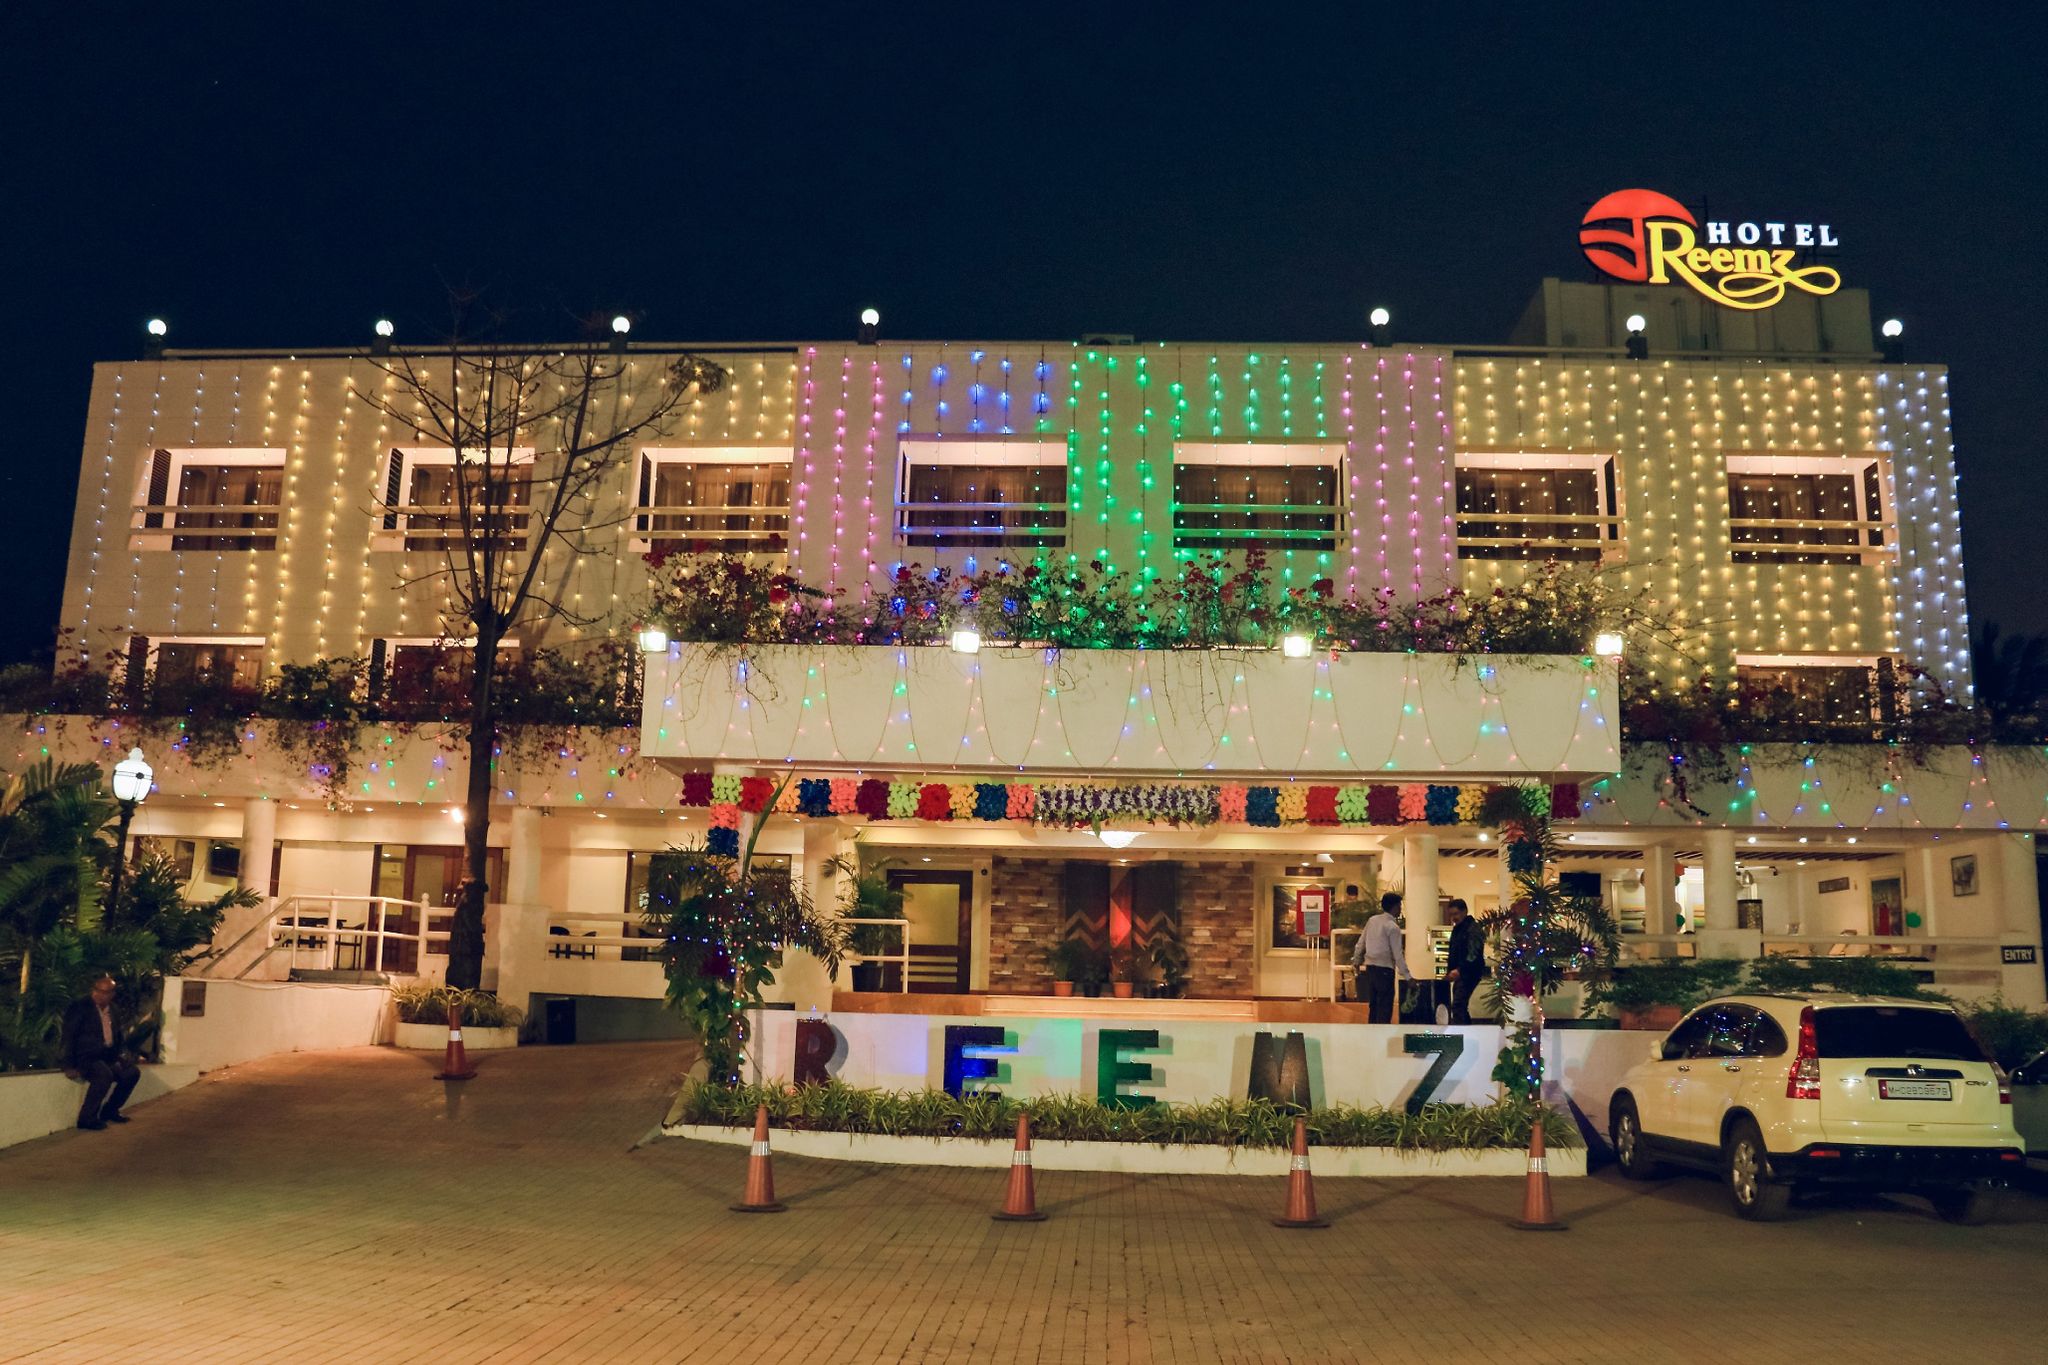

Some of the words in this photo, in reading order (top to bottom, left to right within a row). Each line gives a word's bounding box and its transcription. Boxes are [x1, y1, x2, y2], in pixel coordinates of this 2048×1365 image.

[1707, 222, 1838, 246] HOTEL
[1645, 221, 1841, 310] Reemz
[2004, 949, 2033, 961] ENTRY
